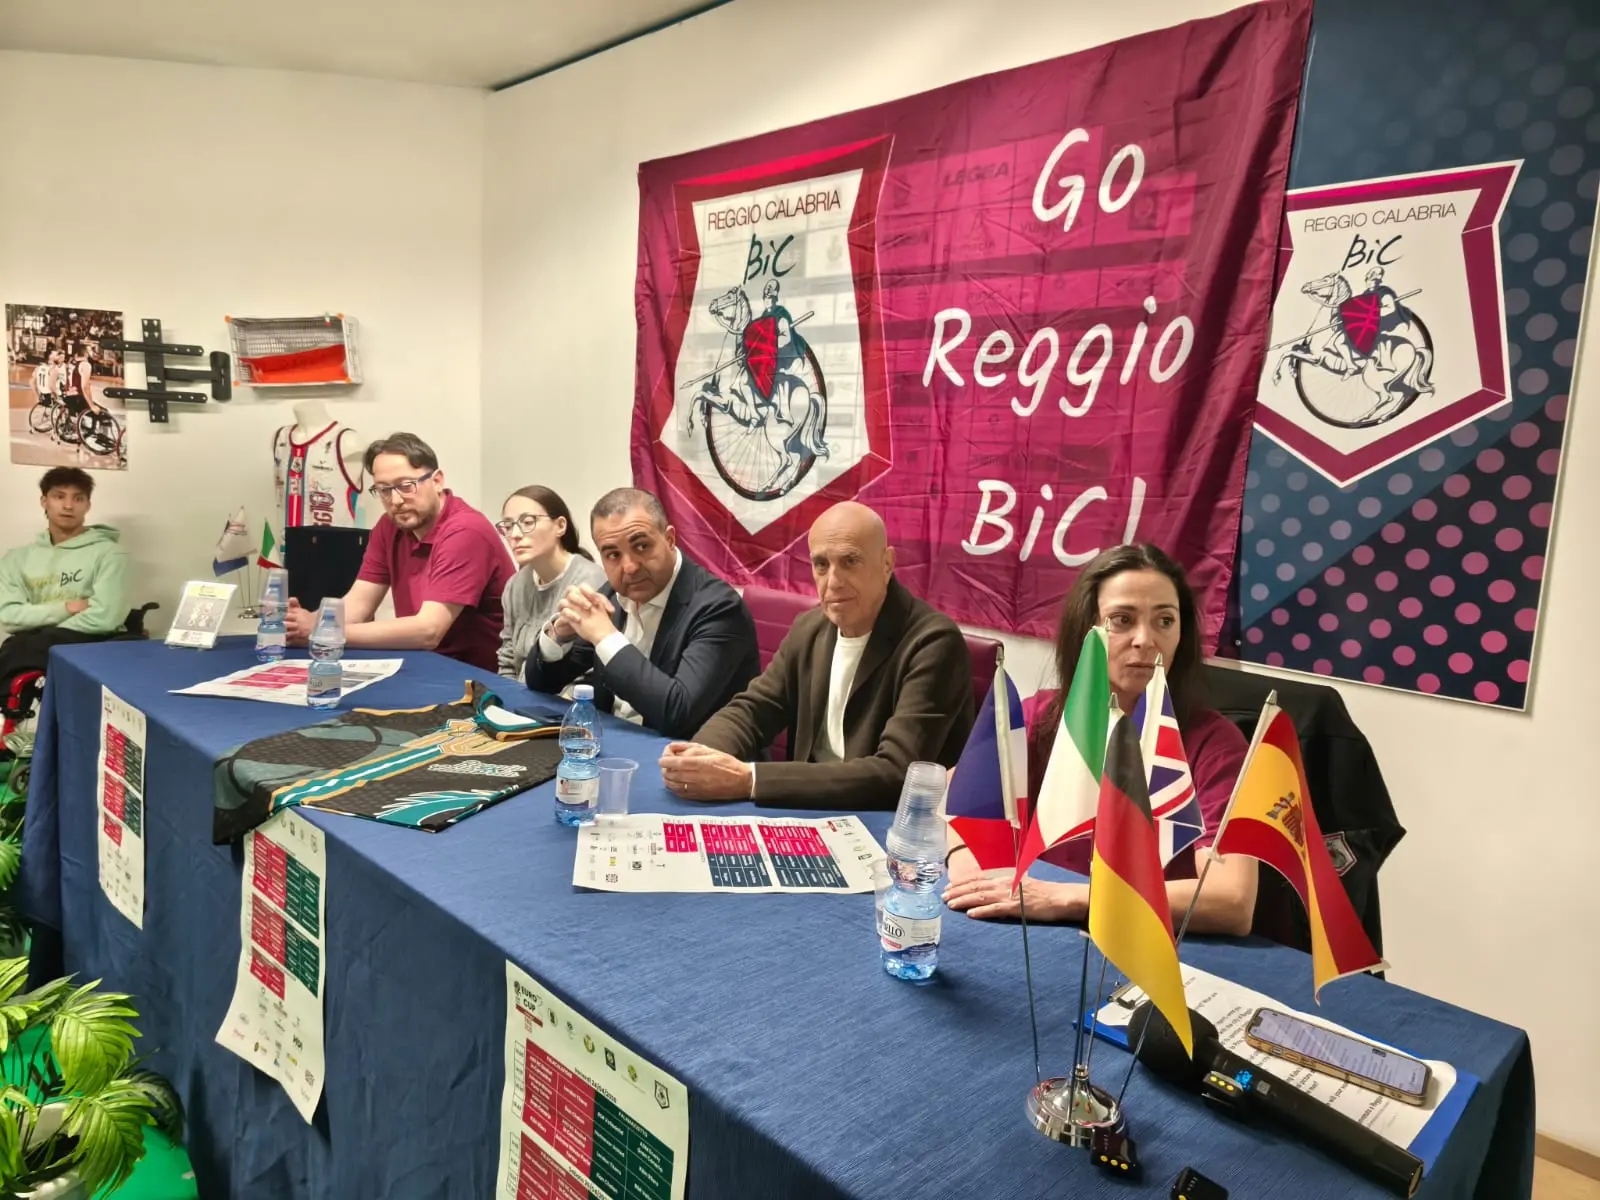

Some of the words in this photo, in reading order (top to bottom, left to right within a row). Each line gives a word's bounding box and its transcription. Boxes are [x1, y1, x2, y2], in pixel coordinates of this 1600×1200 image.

[1032, 127, 1146, 232] Go
[708, 203, 762, 231] REGGIO
[765, 190, 841, 220] CALABRIA
[1304, 213, 1368, 233] REGGIO
[1372, 202, 1457, 225] CALABRIA
[743, 233, 797, 285] BiC
[1341, 233, 1405, 272] BiC
[922, 296, 1195, 417] Reggio
[60, 568, 84, 587] BiC
[521, 986, 538, 1003] EURO
[523, 999, 536, 1012] CUP
